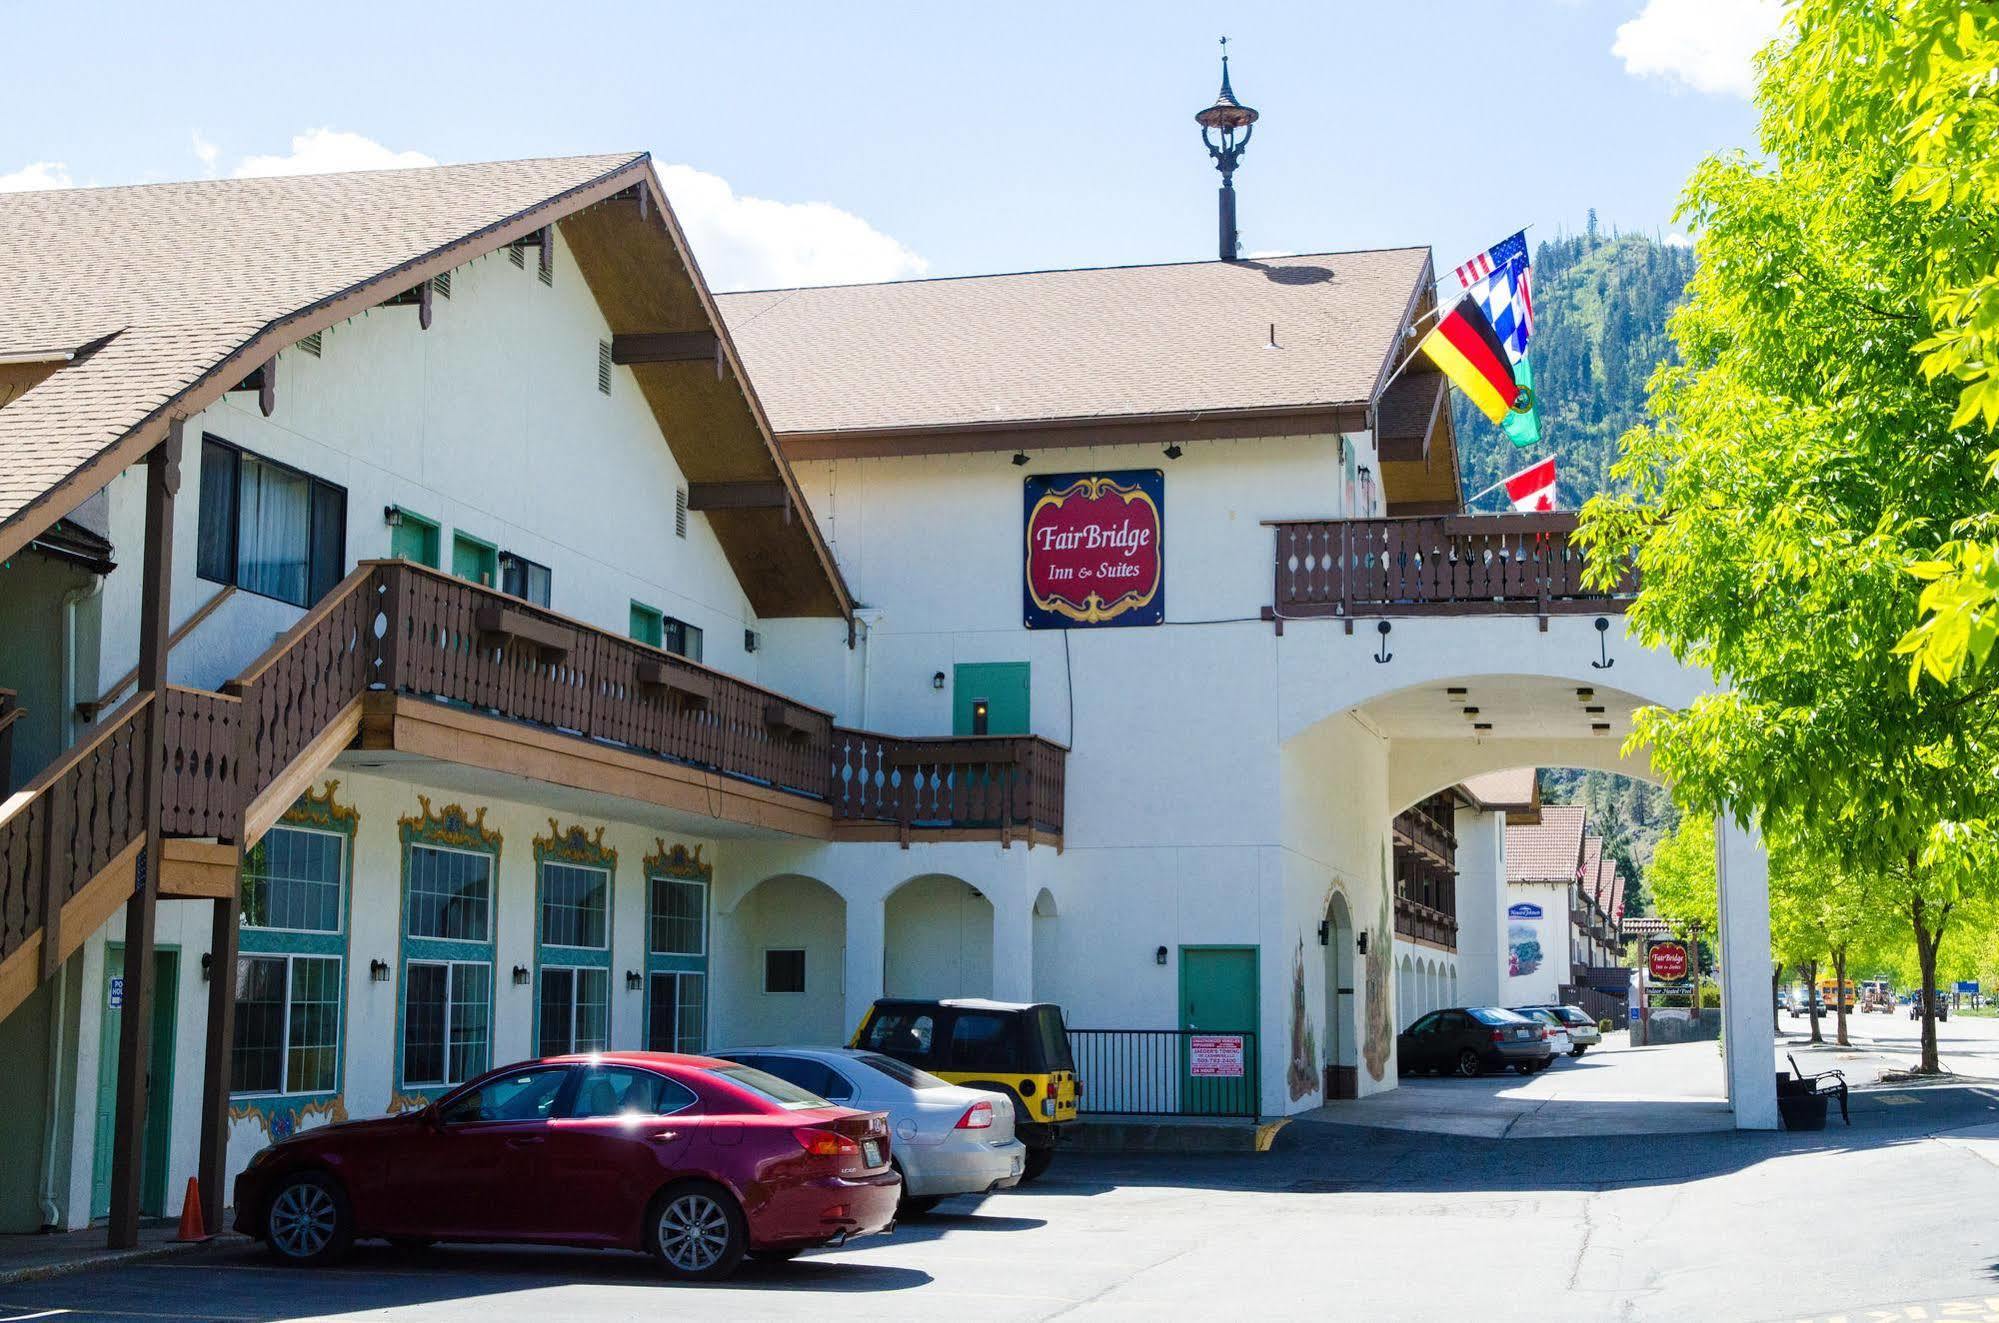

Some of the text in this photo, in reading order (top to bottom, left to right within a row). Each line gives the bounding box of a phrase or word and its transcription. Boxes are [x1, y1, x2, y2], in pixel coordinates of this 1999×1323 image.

[1037, 519, 1150, 556] FairBridge
[1048, 562, 1140, 580] Inn & Suites
[1651, 953, 1684, 964] FairBridge
